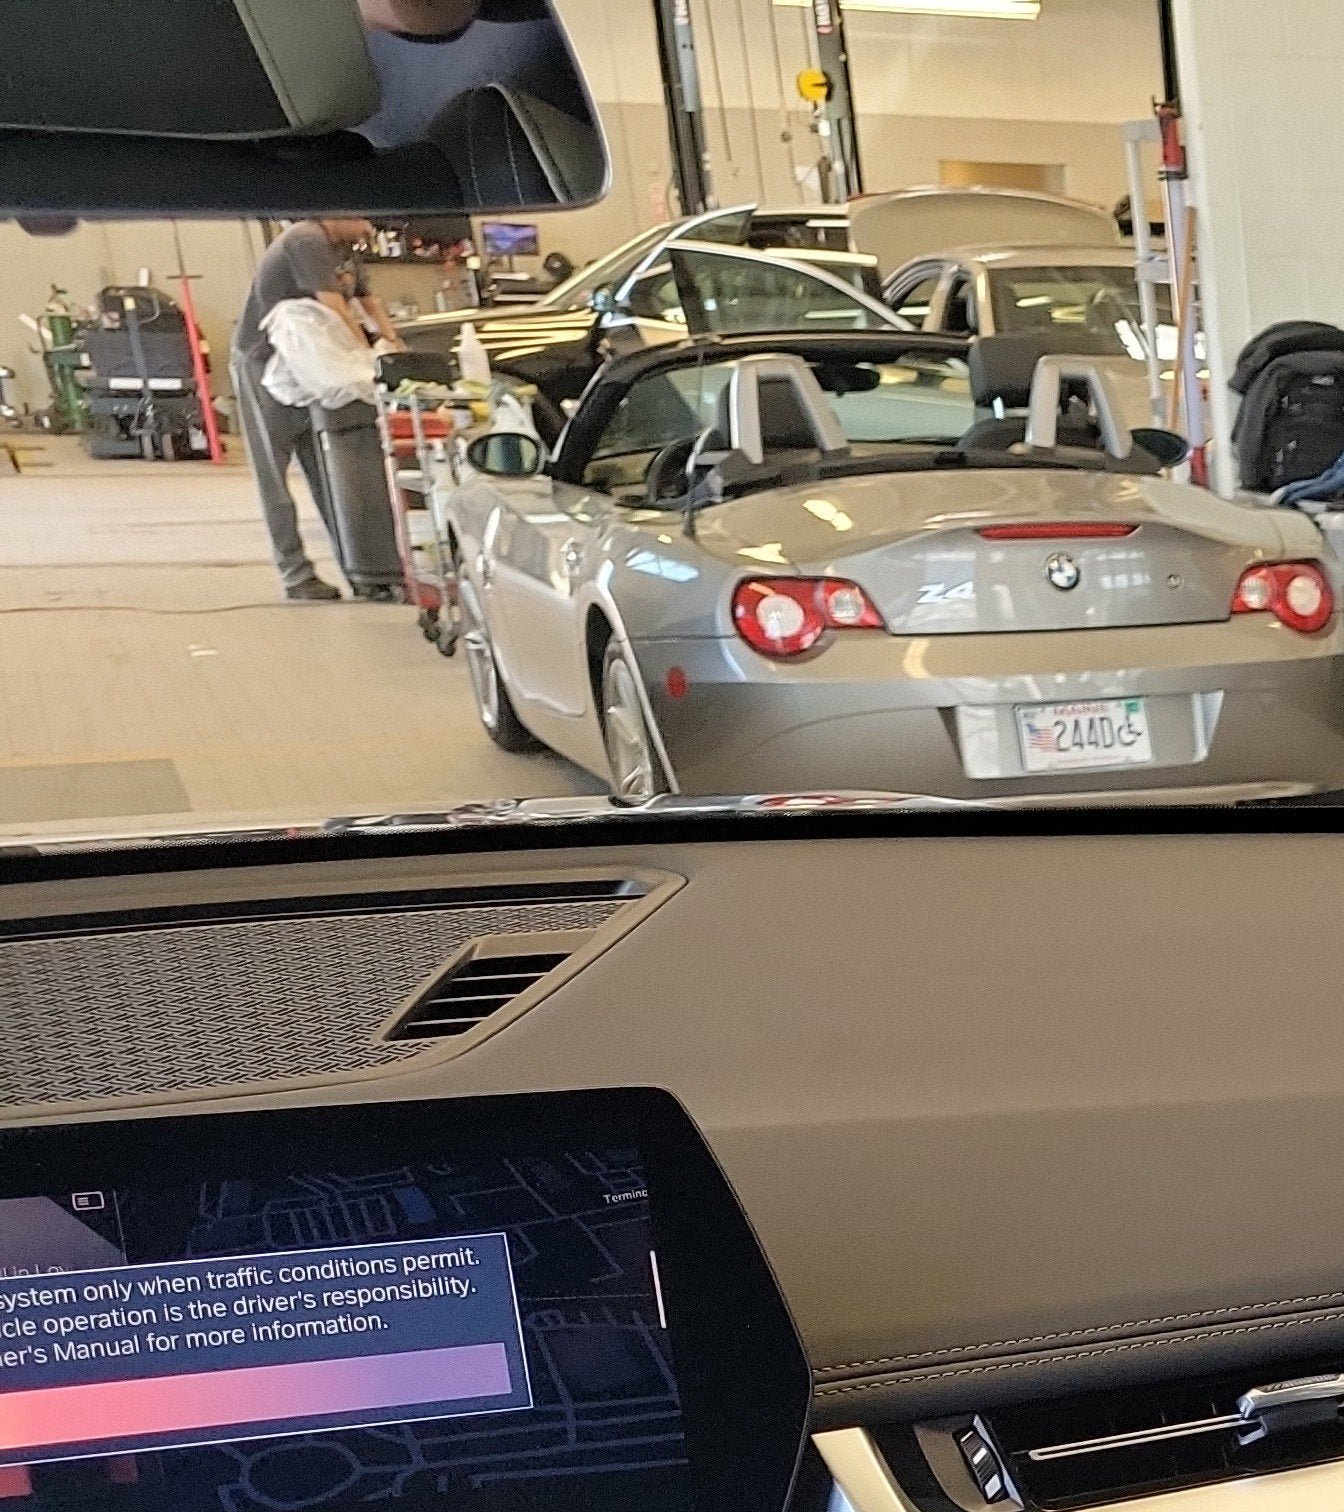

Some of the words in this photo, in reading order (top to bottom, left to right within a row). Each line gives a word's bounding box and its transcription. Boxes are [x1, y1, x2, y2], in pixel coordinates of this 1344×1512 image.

[84, 1279, 132, 1302] only
[138, 1275, 200, 1297] when
[206, 1266, 274, 1290] traffic
[278, 1259, 397, 1284] conditions
[403, 1248, 480, 1275] permit.
[43, 1307, 157, 1337] operation
[163, 1303, 183, 1323] is
[188, 1300, 227, 1320] the
[233, 1290, 317, 1316] driver's
[323, 1277, 477, 1307] responsibility.
[0, 1345, 48, 1368] er's
[53, 1335, 140, 1361] Manual
[146, 1332, 180, 1353] for
[186, 1328, 245, 1348] more
[251, 1314, 388, 1342] information.
